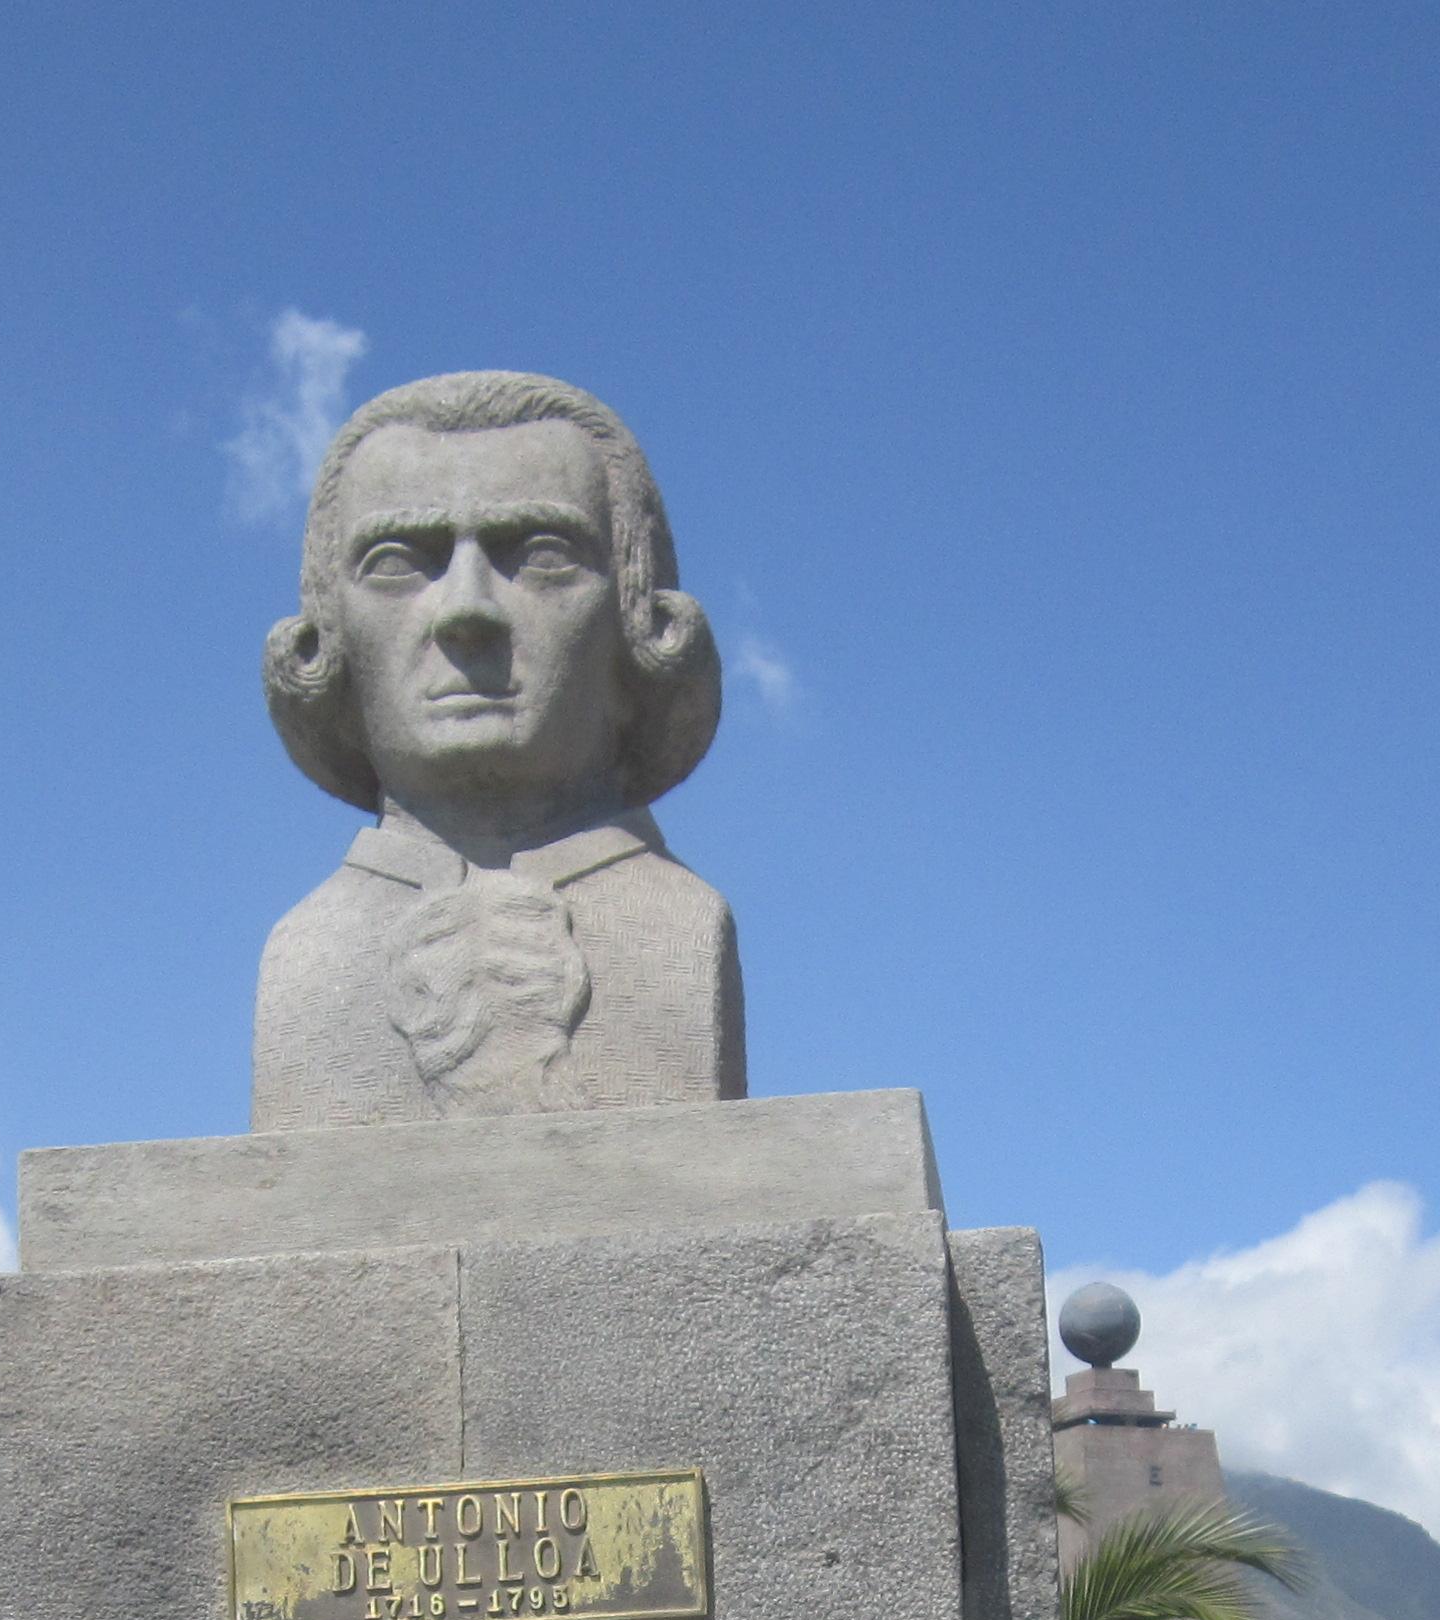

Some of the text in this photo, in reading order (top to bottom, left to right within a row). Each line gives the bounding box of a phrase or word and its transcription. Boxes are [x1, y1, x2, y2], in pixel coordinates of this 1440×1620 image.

[339, 1488, 588, 1546] ANTONIO
[329, 1536, 601, 1594] DE ULLOA
